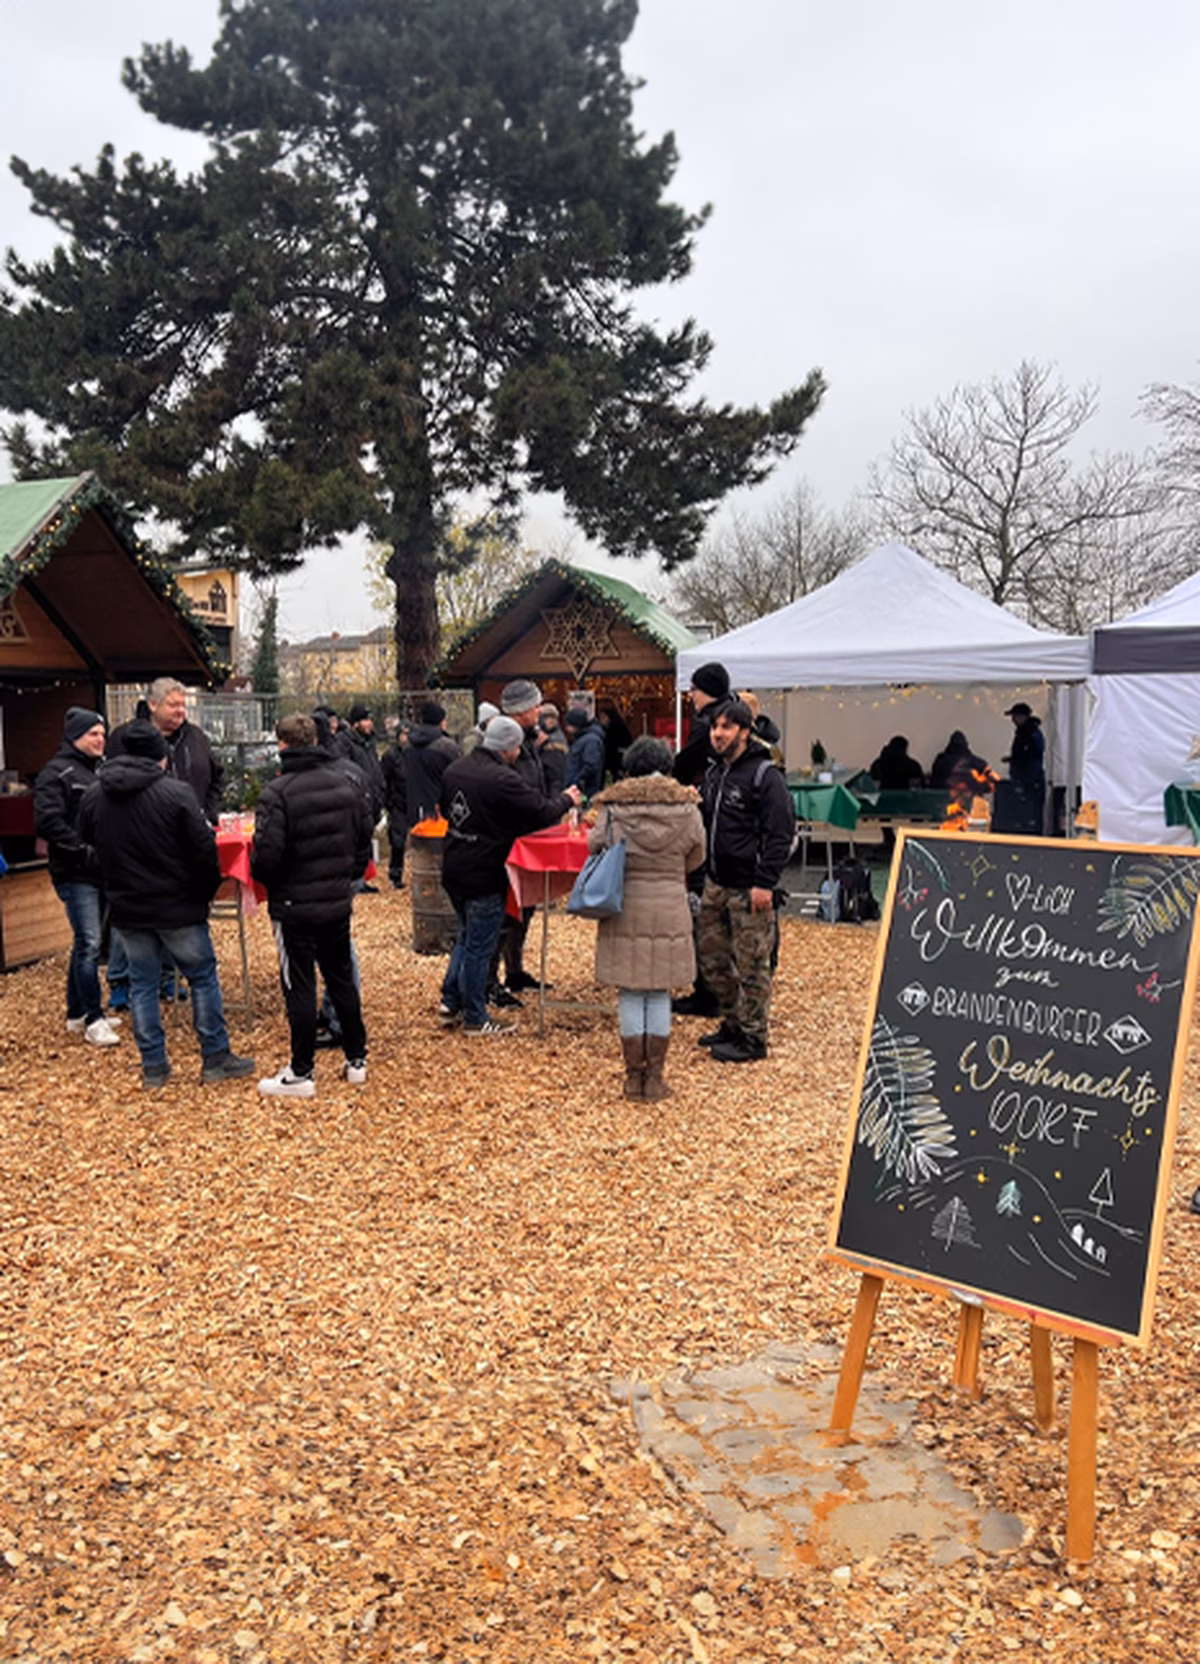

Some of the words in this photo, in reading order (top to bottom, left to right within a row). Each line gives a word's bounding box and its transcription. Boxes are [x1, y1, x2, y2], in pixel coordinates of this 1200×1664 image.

[994, 966, 1060, 988] zum
[931, 986, 1101, 1046] BRANDENBURGER
[988, 1090, 1098, 1148] DORF
